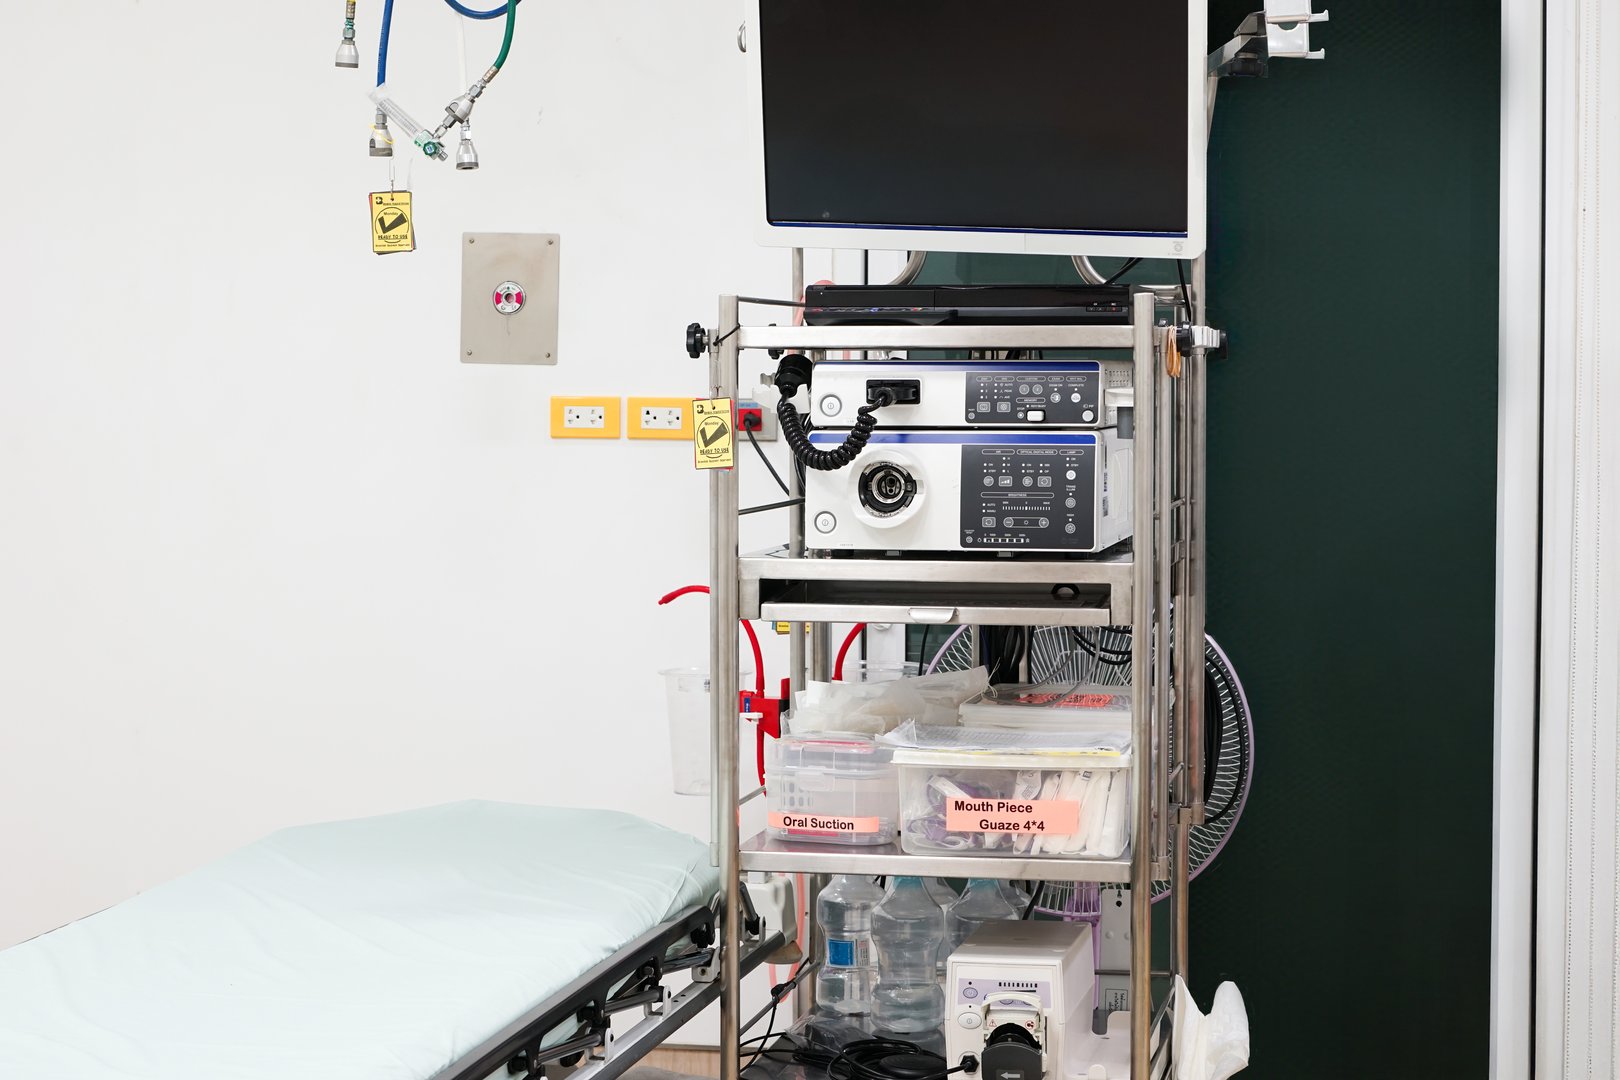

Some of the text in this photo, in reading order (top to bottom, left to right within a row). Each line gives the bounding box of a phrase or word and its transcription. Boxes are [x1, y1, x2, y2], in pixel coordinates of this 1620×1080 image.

[954, 800, 1033, 813] Mouth Piece
[783, 816, 854, 830] Oral Suction
[979, 820, 1020, 830] Guaze
